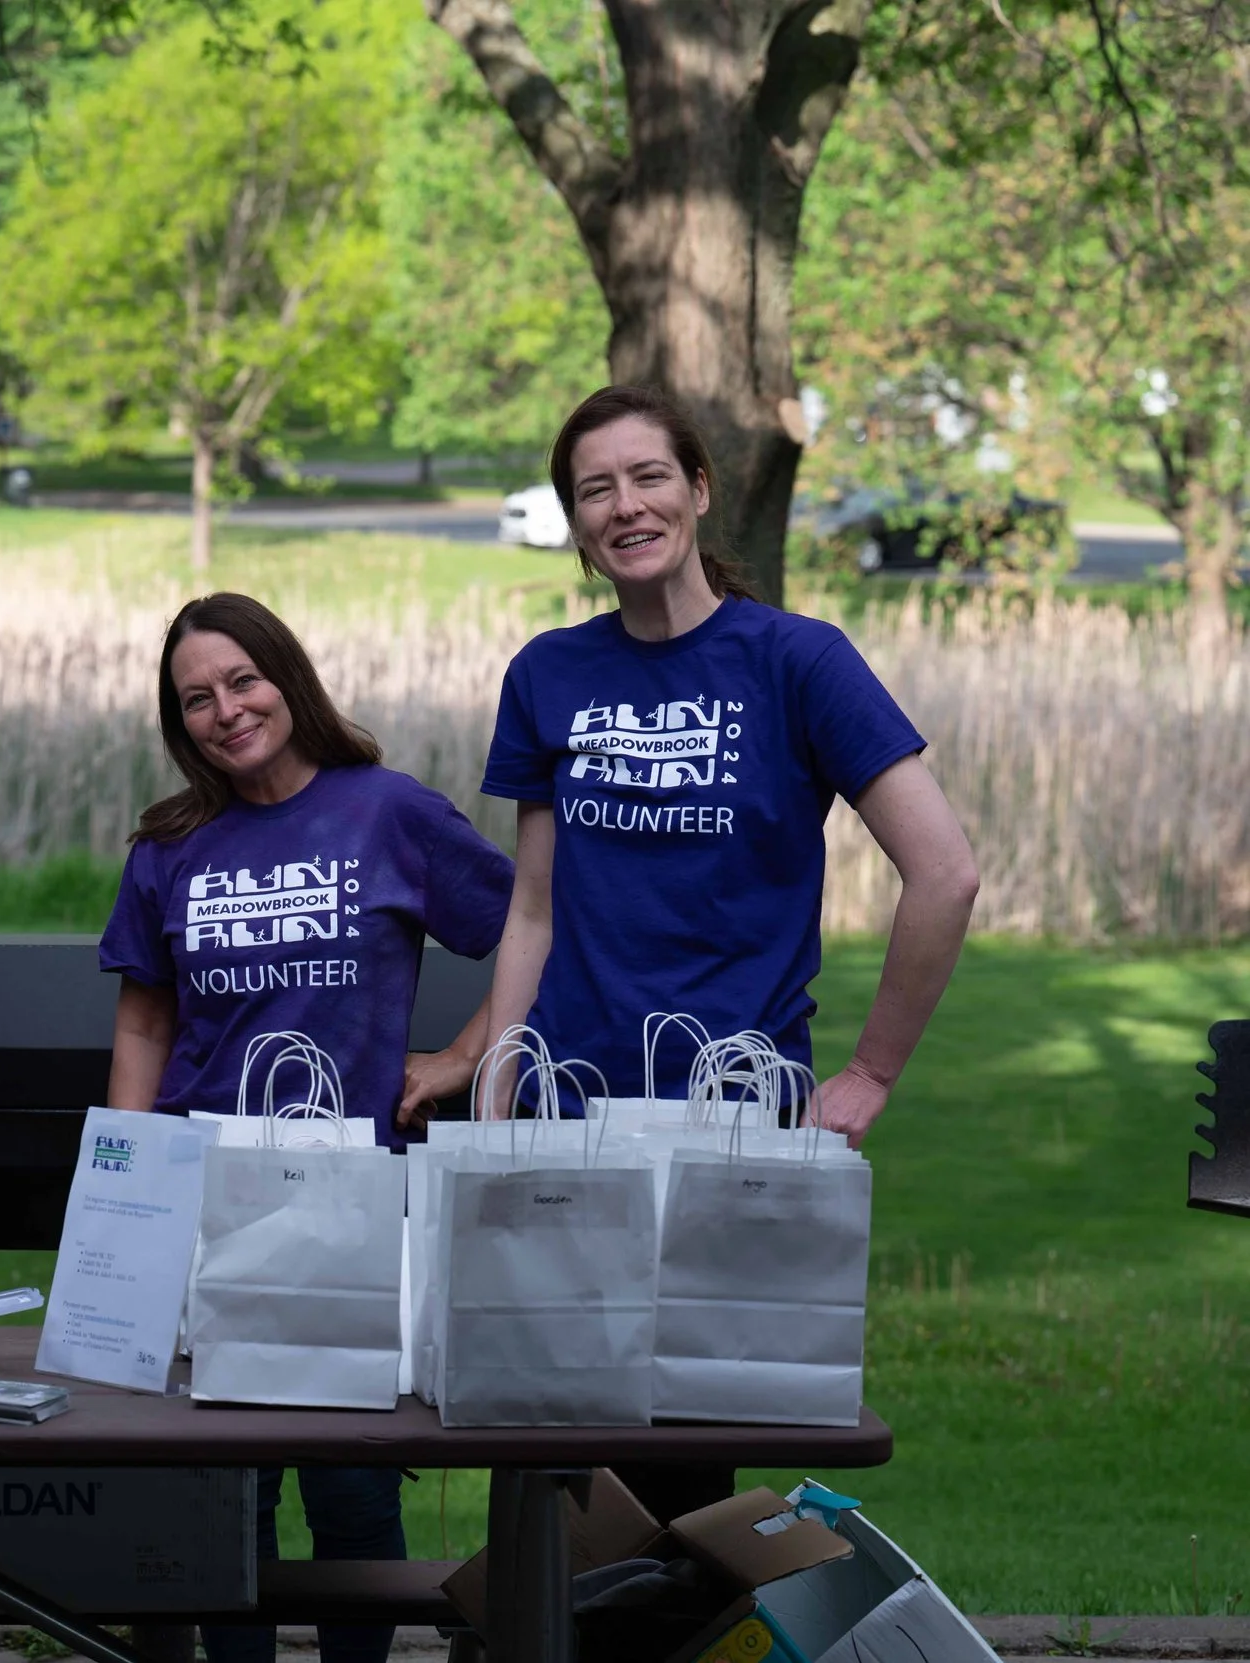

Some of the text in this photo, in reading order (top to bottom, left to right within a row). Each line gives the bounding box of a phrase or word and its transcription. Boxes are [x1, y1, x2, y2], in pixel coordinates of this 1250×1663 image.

[570, 699, 721, 734] RUN
[577, 736, 710, 753] MEADOWBROOK
[721, 701, 744, 785] 2024
[569, 753, 716, 788] RUN
[562, 797, 735, 835] VOLUNTEER
[188, 860, 338, 899] RUN
[344, 858, 360, 938] 2024
[196, 893, 330, 917] MEADOWBROOK
[185, 912, 339, 952] RUN
[190, 959, 358, 996] VOLUNTEER
